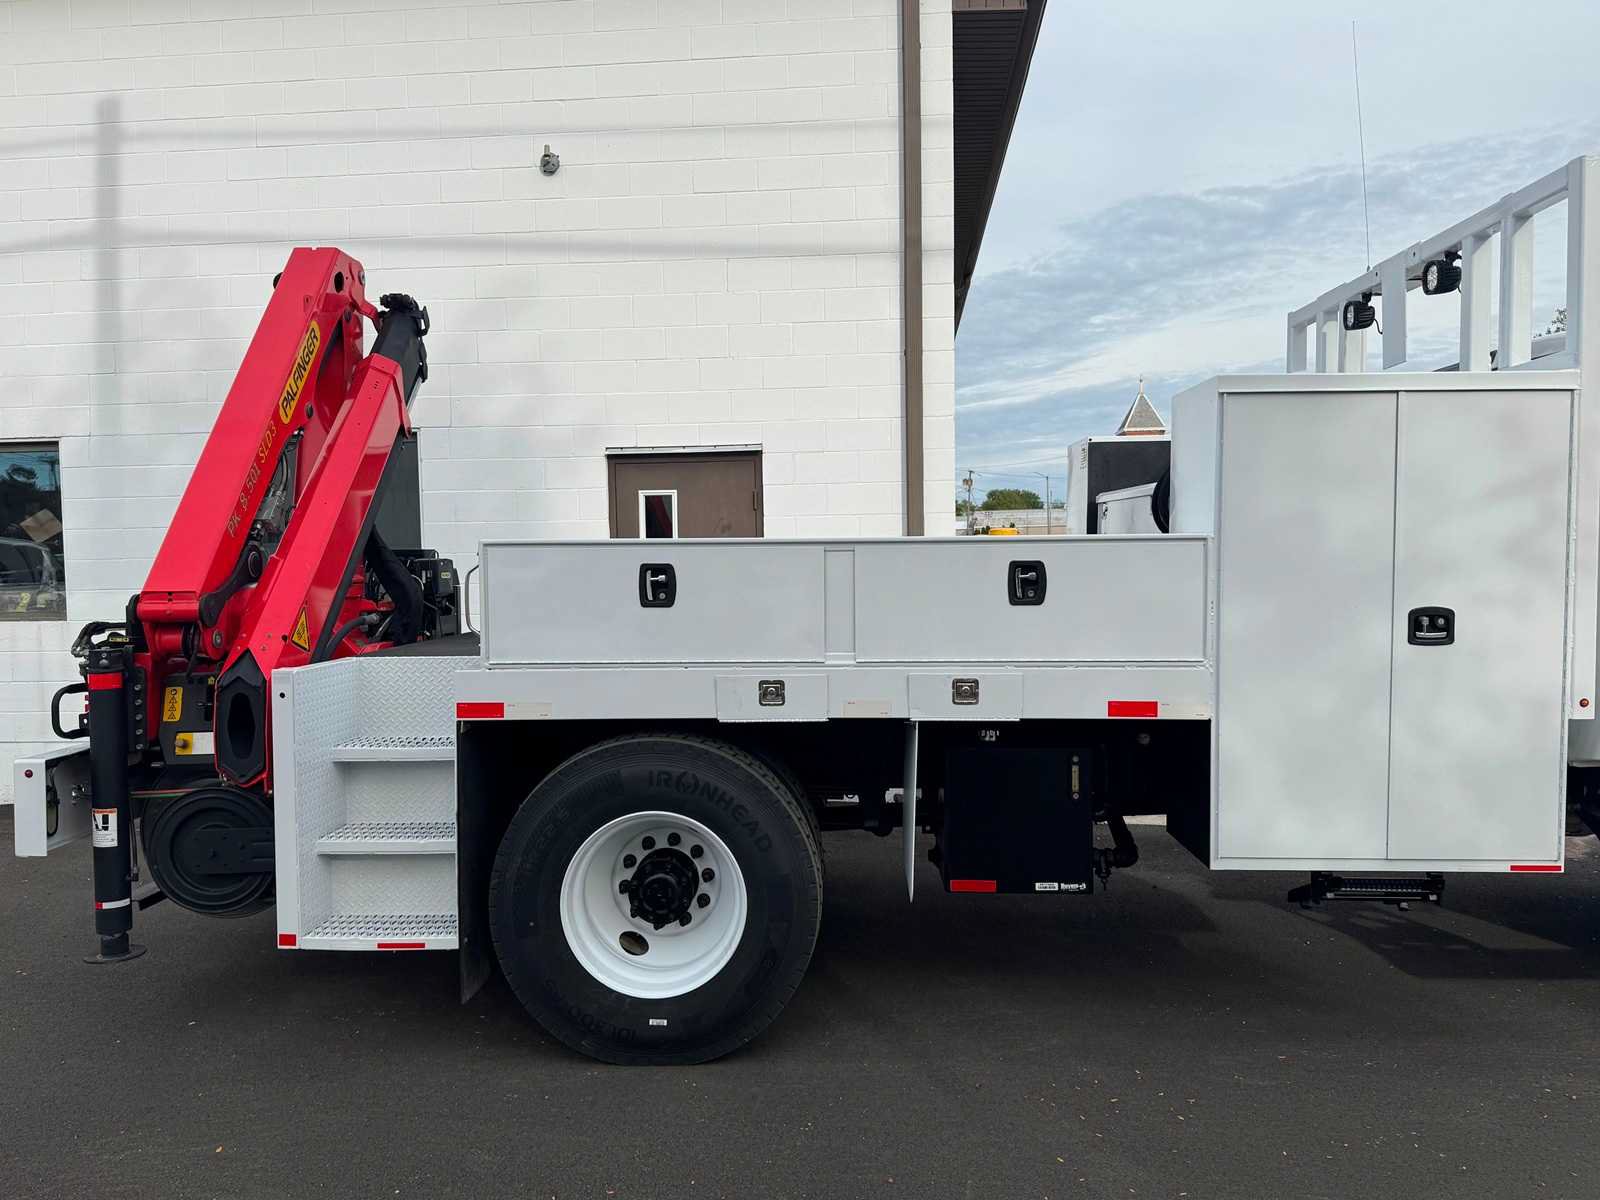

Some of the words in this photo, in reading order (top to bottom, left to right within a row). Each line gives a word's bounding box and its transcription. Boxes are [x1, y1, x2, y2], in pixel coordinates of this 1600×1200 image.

[281, 327, 319, 418] PALFINGER
[228, 512, 241, 537] PK
[648, 769, 773, 853] IRONHEAD
